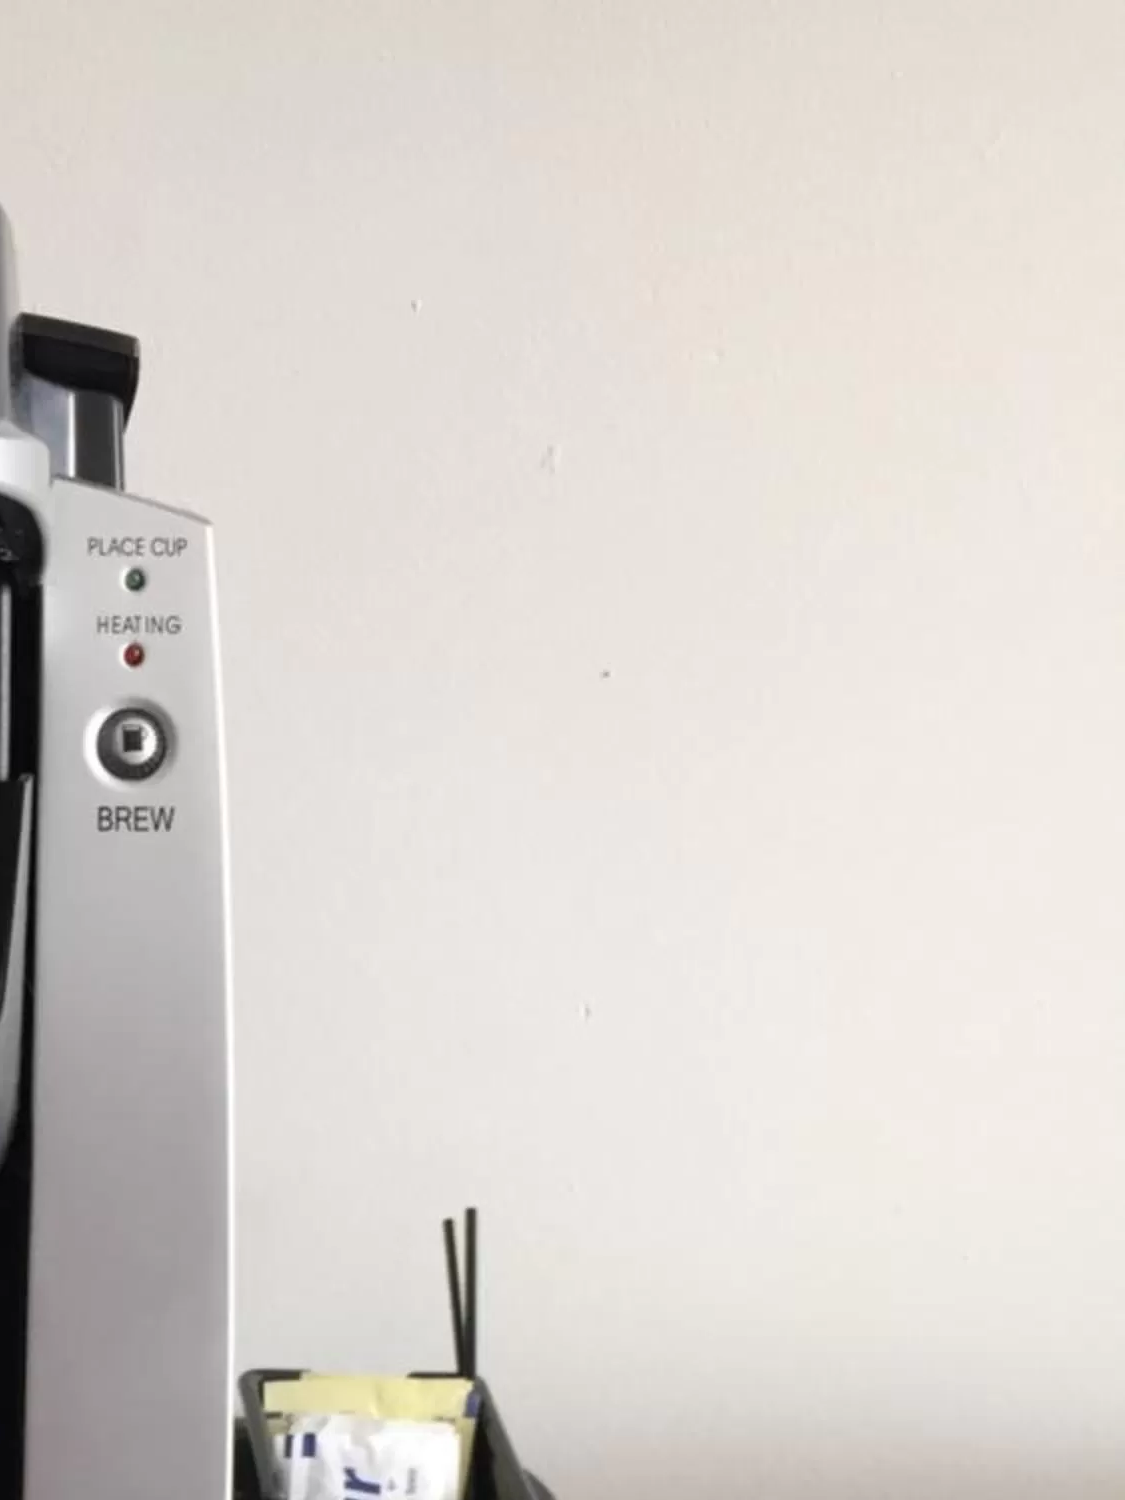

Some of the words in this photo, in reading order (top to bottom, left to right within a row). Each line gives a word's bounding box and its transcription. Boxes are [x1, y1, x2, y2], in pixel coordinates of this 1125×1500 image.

[86, 536, 146, 557] PLACE
[150, 536, 188, 557] CUP
[96, 615, 183, 635] HEATING
[97, 805, 175, 832] BREW
